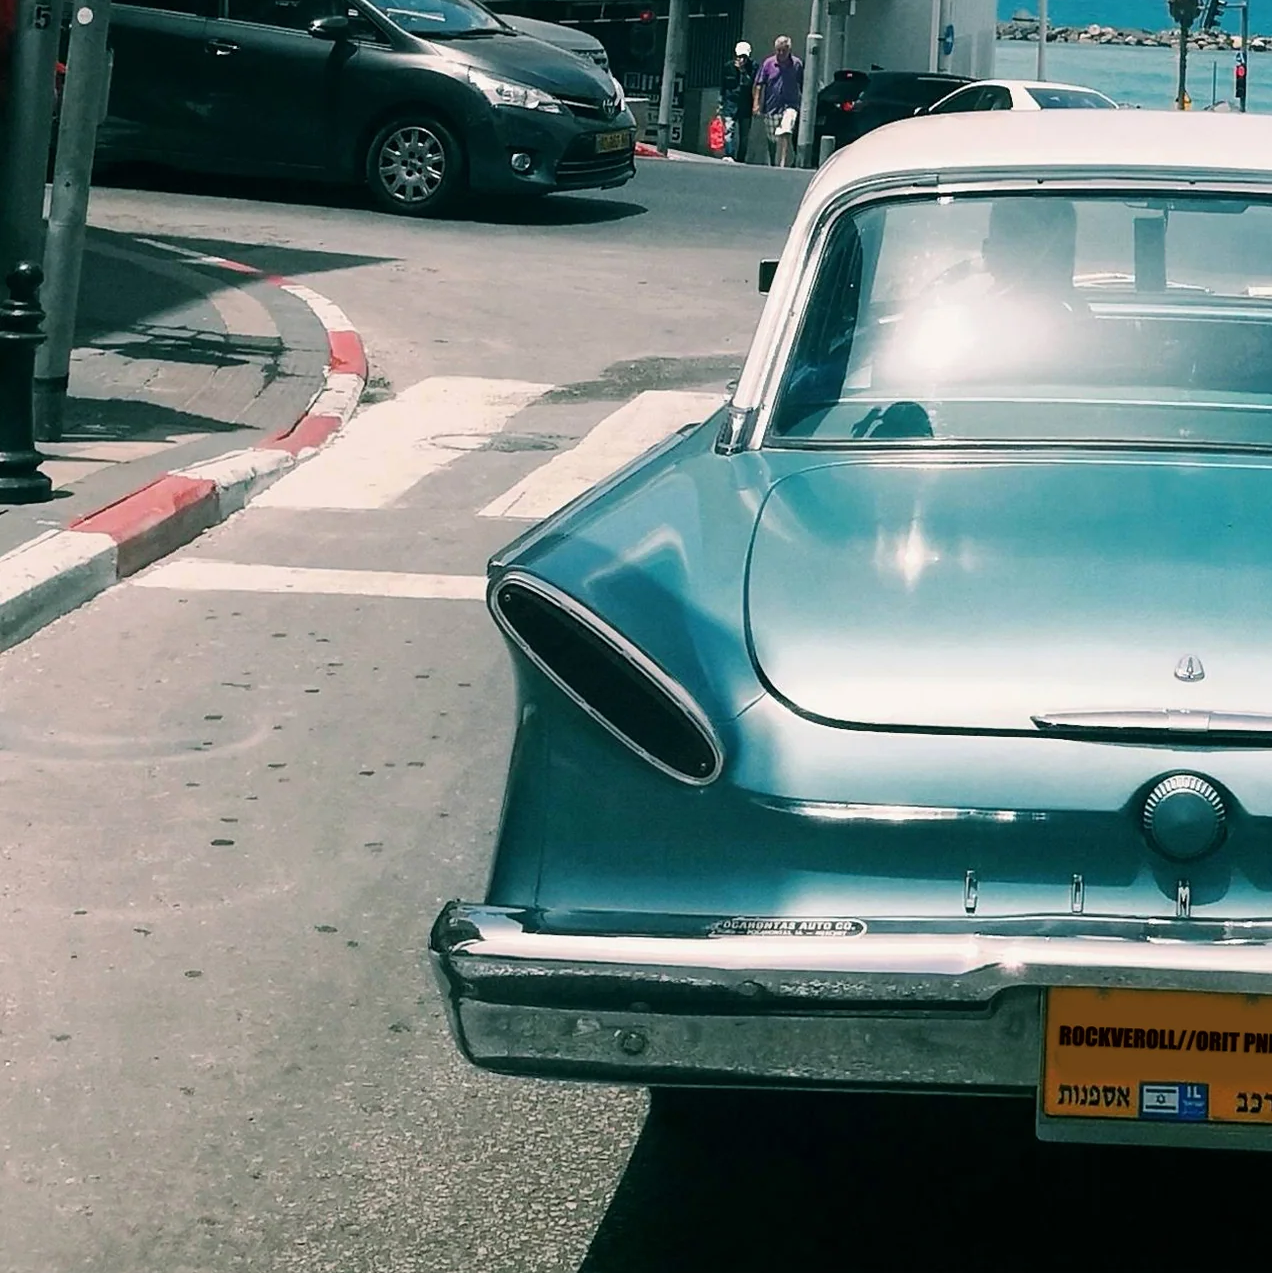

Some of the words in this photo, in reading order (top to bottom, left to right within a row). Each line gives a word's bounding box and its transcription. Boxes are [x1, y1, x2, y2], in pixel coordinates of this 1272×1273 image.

[35, 5, 52, 29] 5
[799, 920, 832, 930] AUTO
[1059, 1025, 1240, 1053] ROCKVEROLL//ORIT
[1057, 1083, 1131, 1108] אספנות
[1187, 1085, 1202, 1098] IL
